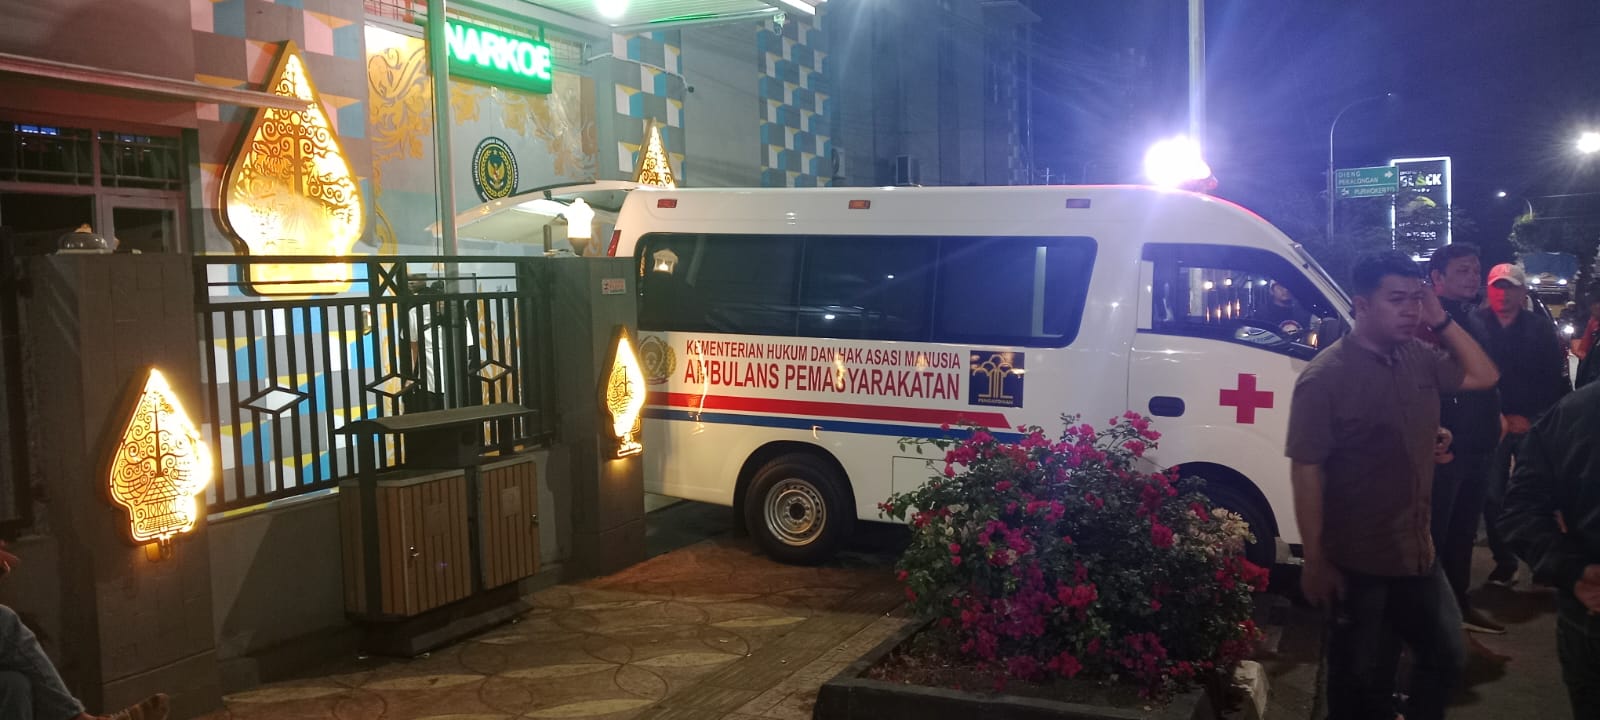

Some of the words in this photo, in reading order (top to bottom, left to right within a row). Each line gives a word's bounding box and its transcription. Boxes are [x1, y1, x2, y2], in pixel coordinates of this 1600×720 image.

[1338, 170, 1361, 178] DIENG
[686, 339, 764, 358] KEMENTERIAN
[767, 343, 808, 361] HUKUM
[810, 345, 835, 362] DAN
[838, 347, 863, 364] HAK
[865, 348, 901, 366] ASASI
[904, 350, 961, 369] MANUSIA
[684, 359, 780, 389] AMBULANS
[785, 364, 960, 401] PEMASYARAKATAN
